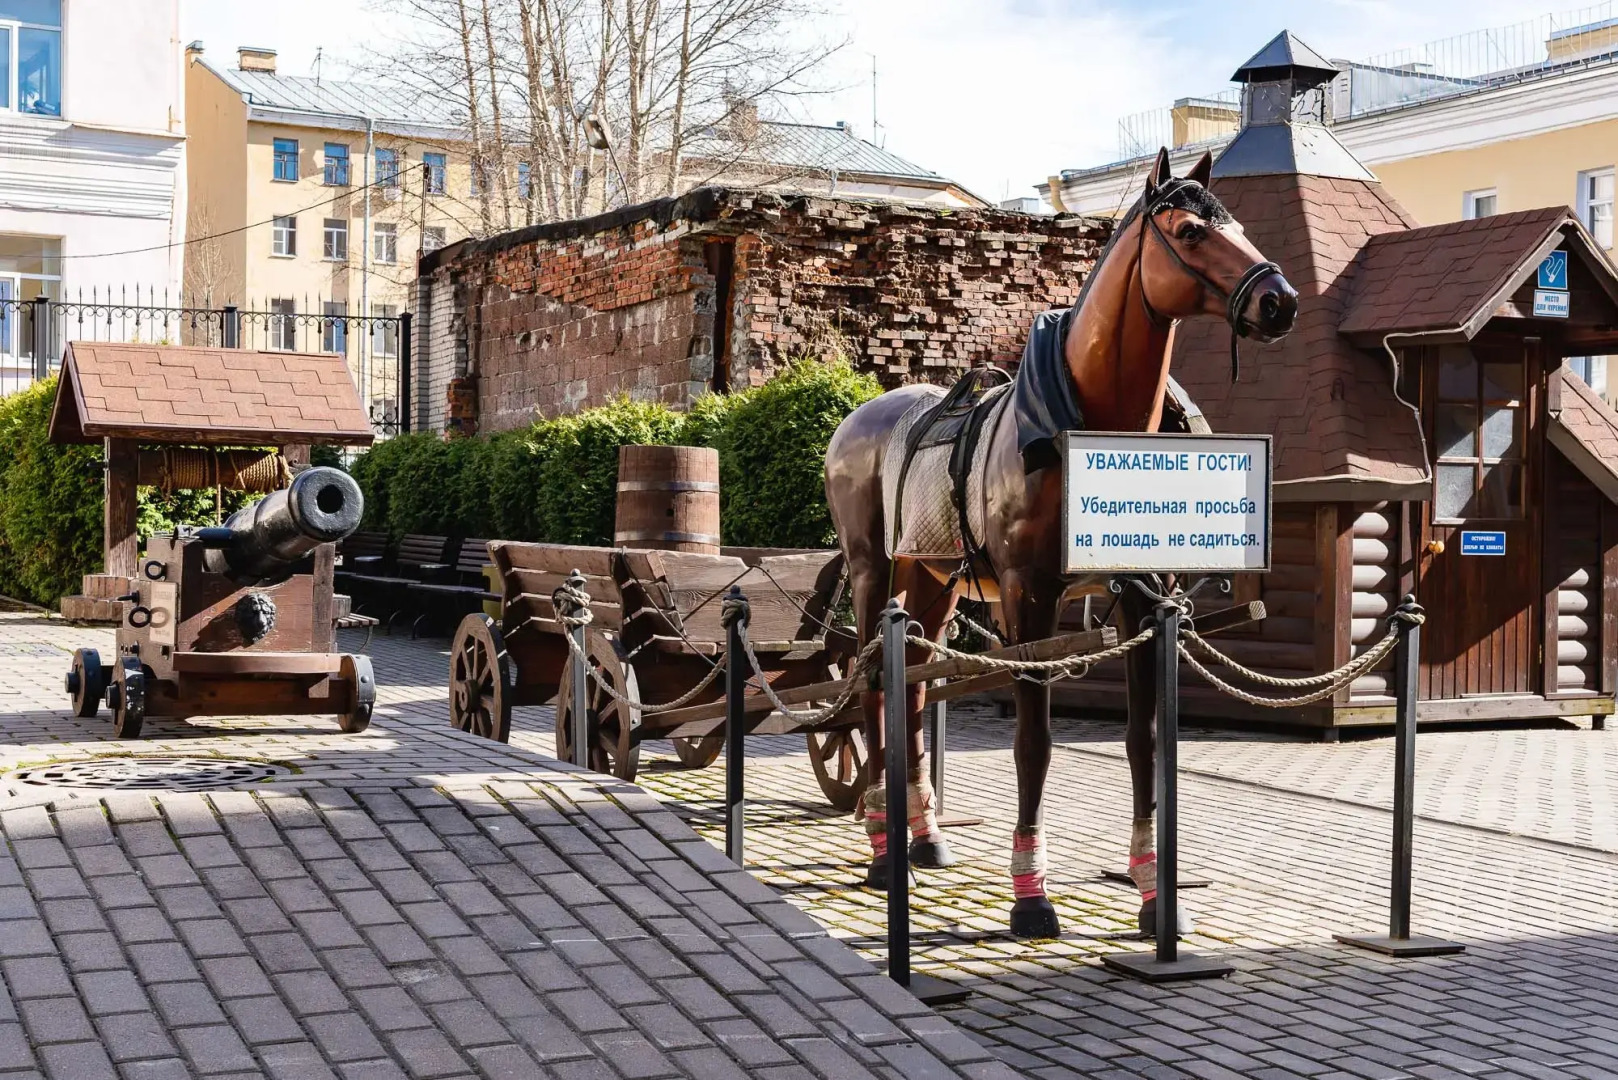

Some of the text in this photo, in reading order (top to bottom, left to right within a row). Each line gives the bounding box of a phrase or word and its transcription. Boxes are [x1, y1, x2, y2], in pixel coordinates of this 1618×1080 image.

[1085, 452, 1252, 472] УВАЖАЕМЫЕ ГОСТИ!
[1080, 496, 1257, 519] Убедительная просьба
[1075, 533, 1261, 550] на лошадь не садиться.
